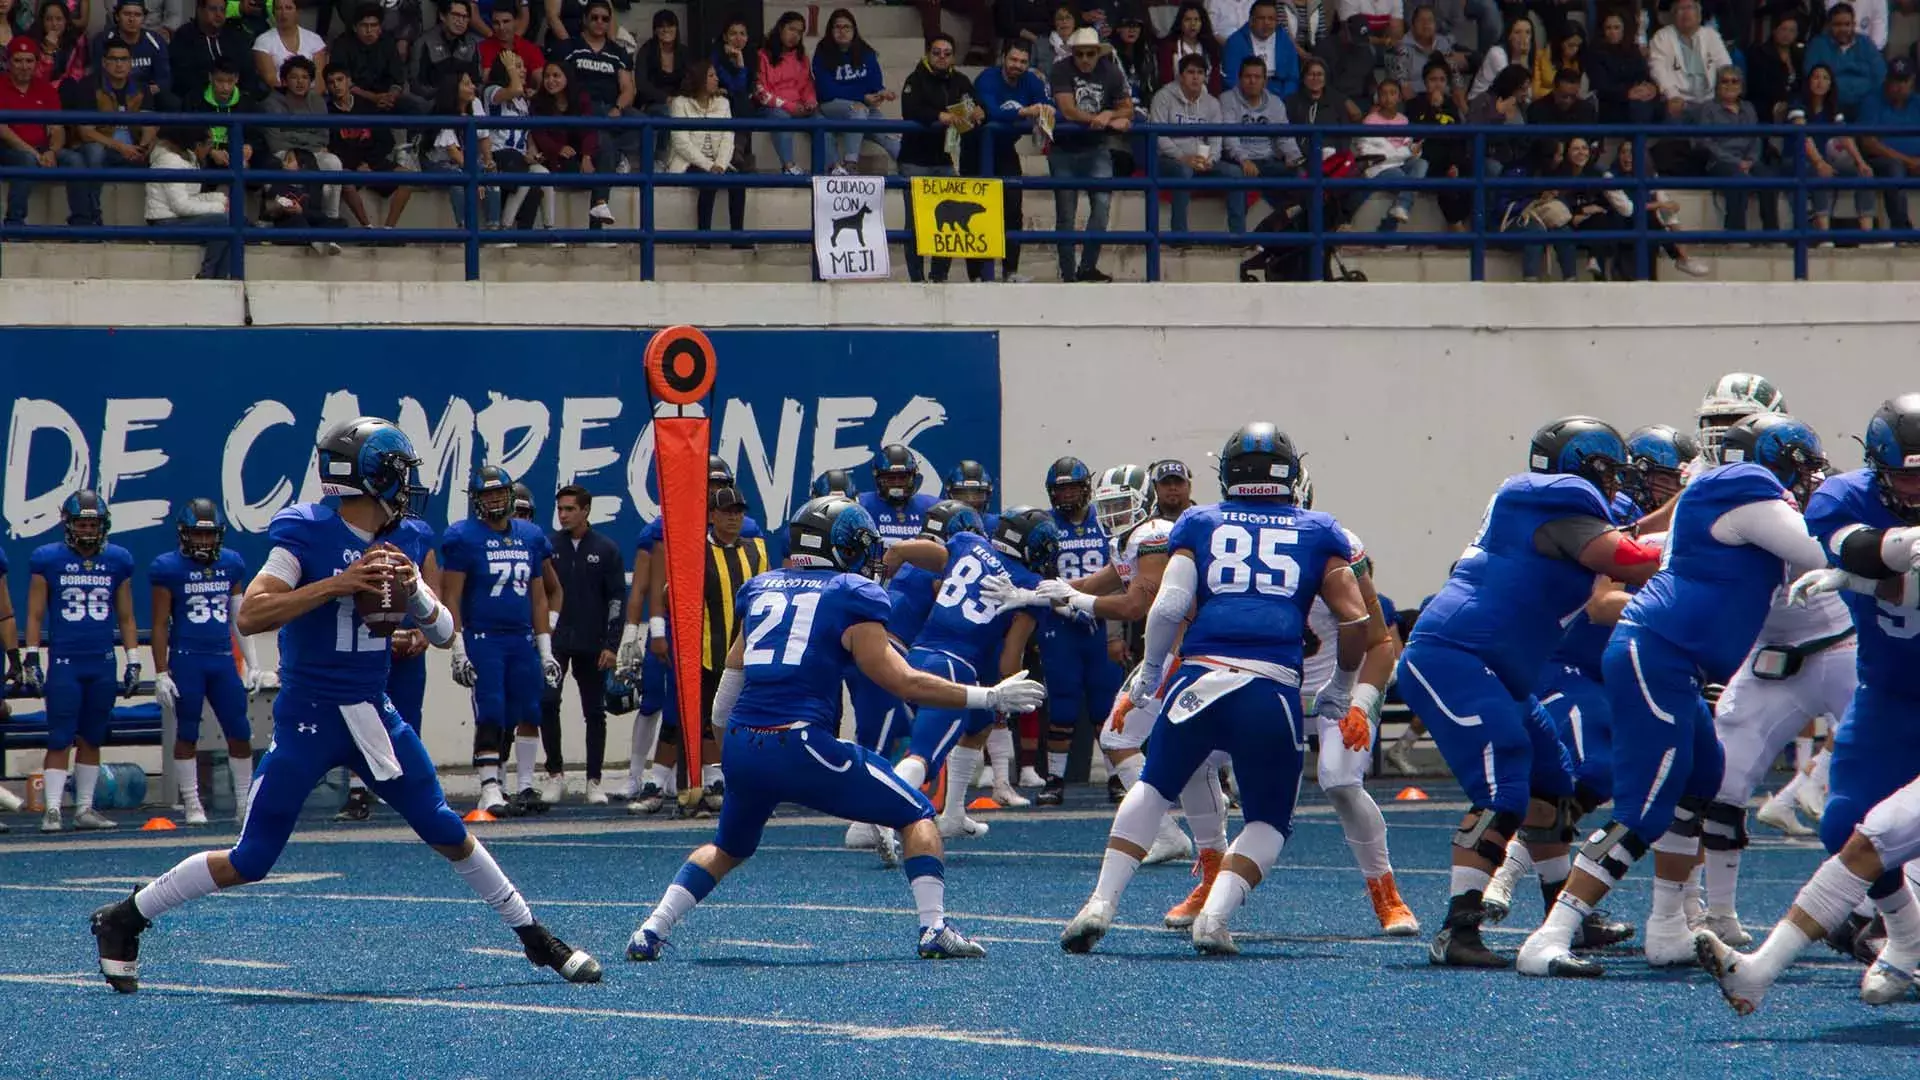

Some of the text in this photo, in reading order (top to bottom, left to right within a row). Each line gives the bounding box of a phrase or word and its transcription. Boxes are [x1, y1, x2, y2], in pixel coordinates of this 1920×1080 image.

[576, 59, 615, 73] TOLUCA
[827, 179, 876, 194] CUIDADO
[923, 178, 989, 195] BEWARE OF
[833, 197, 860, 212] CON
[934, 232, 988, 253] BEARS
[829, 248, 876, 274] MEJI
[3, 397, 173, 539] DE
[1161, 463, 1182, 473] TEC
[1238, 485, 1279, 495] Riddell
[487, 550, 529, 561] BORREGOS
[1207, 524, 1300, 598] 85
[1057, 550, 1104, 580] 69
[60, 575, 112, 585] BORREGOS
[184, 581, 230, 594] BORREGOS
[61, 587, 111, 622] 36
[185, 595, 229, 624] 33
[743, 591, 821, 665] 21
